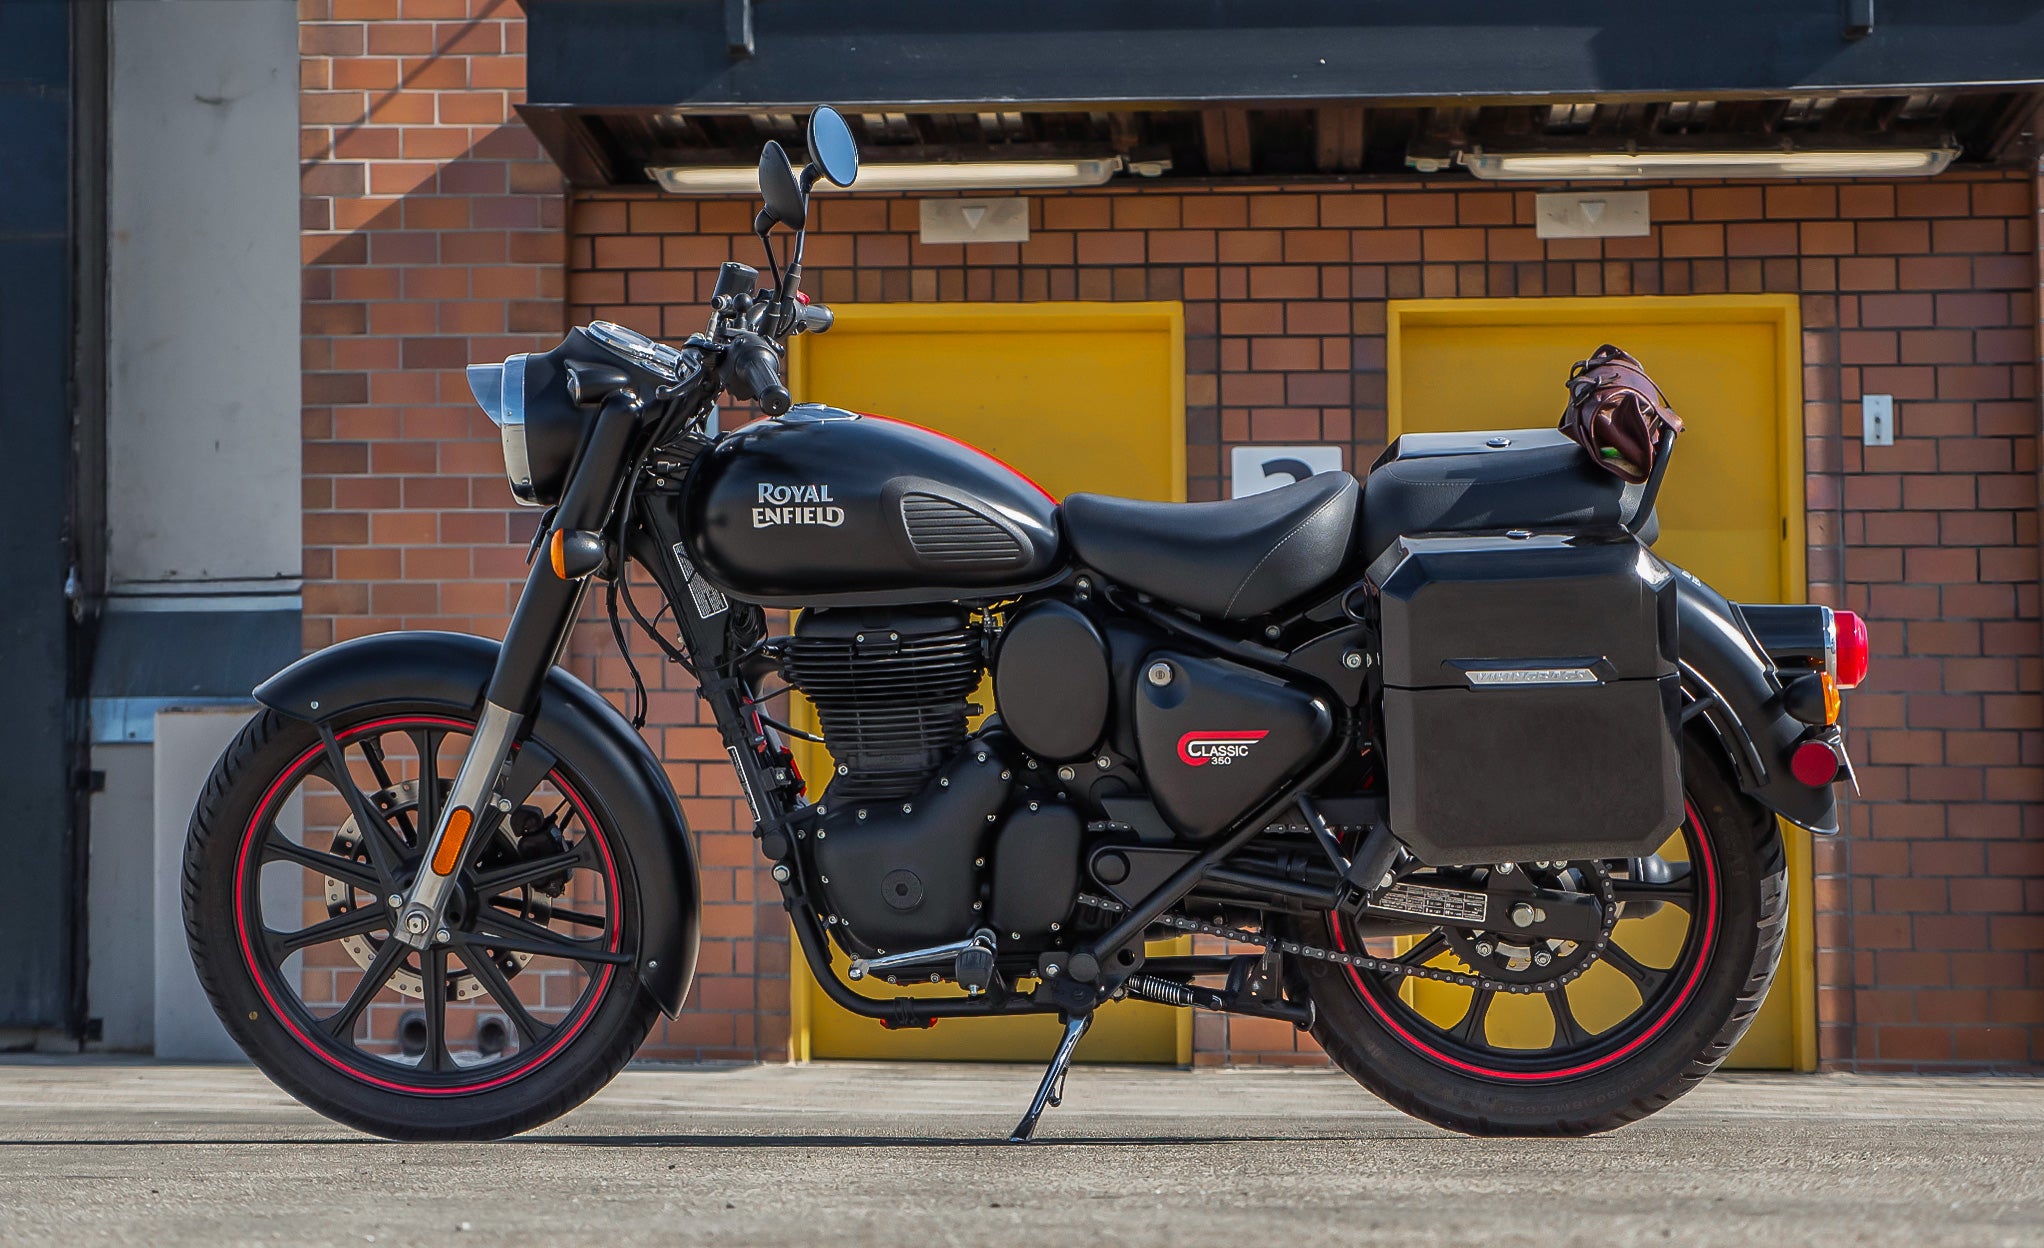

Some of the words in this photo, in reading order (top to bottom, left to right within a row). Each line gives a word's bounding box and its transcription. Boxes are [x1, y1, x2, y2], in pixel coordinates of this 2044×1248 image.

[758, 482, 834, 505] ROYAL
[752, 506, 845, 528] ENFIELD
[1187, 740, 1259, 757] CLASSIC
[1211, 756, 1232, 765] 350
